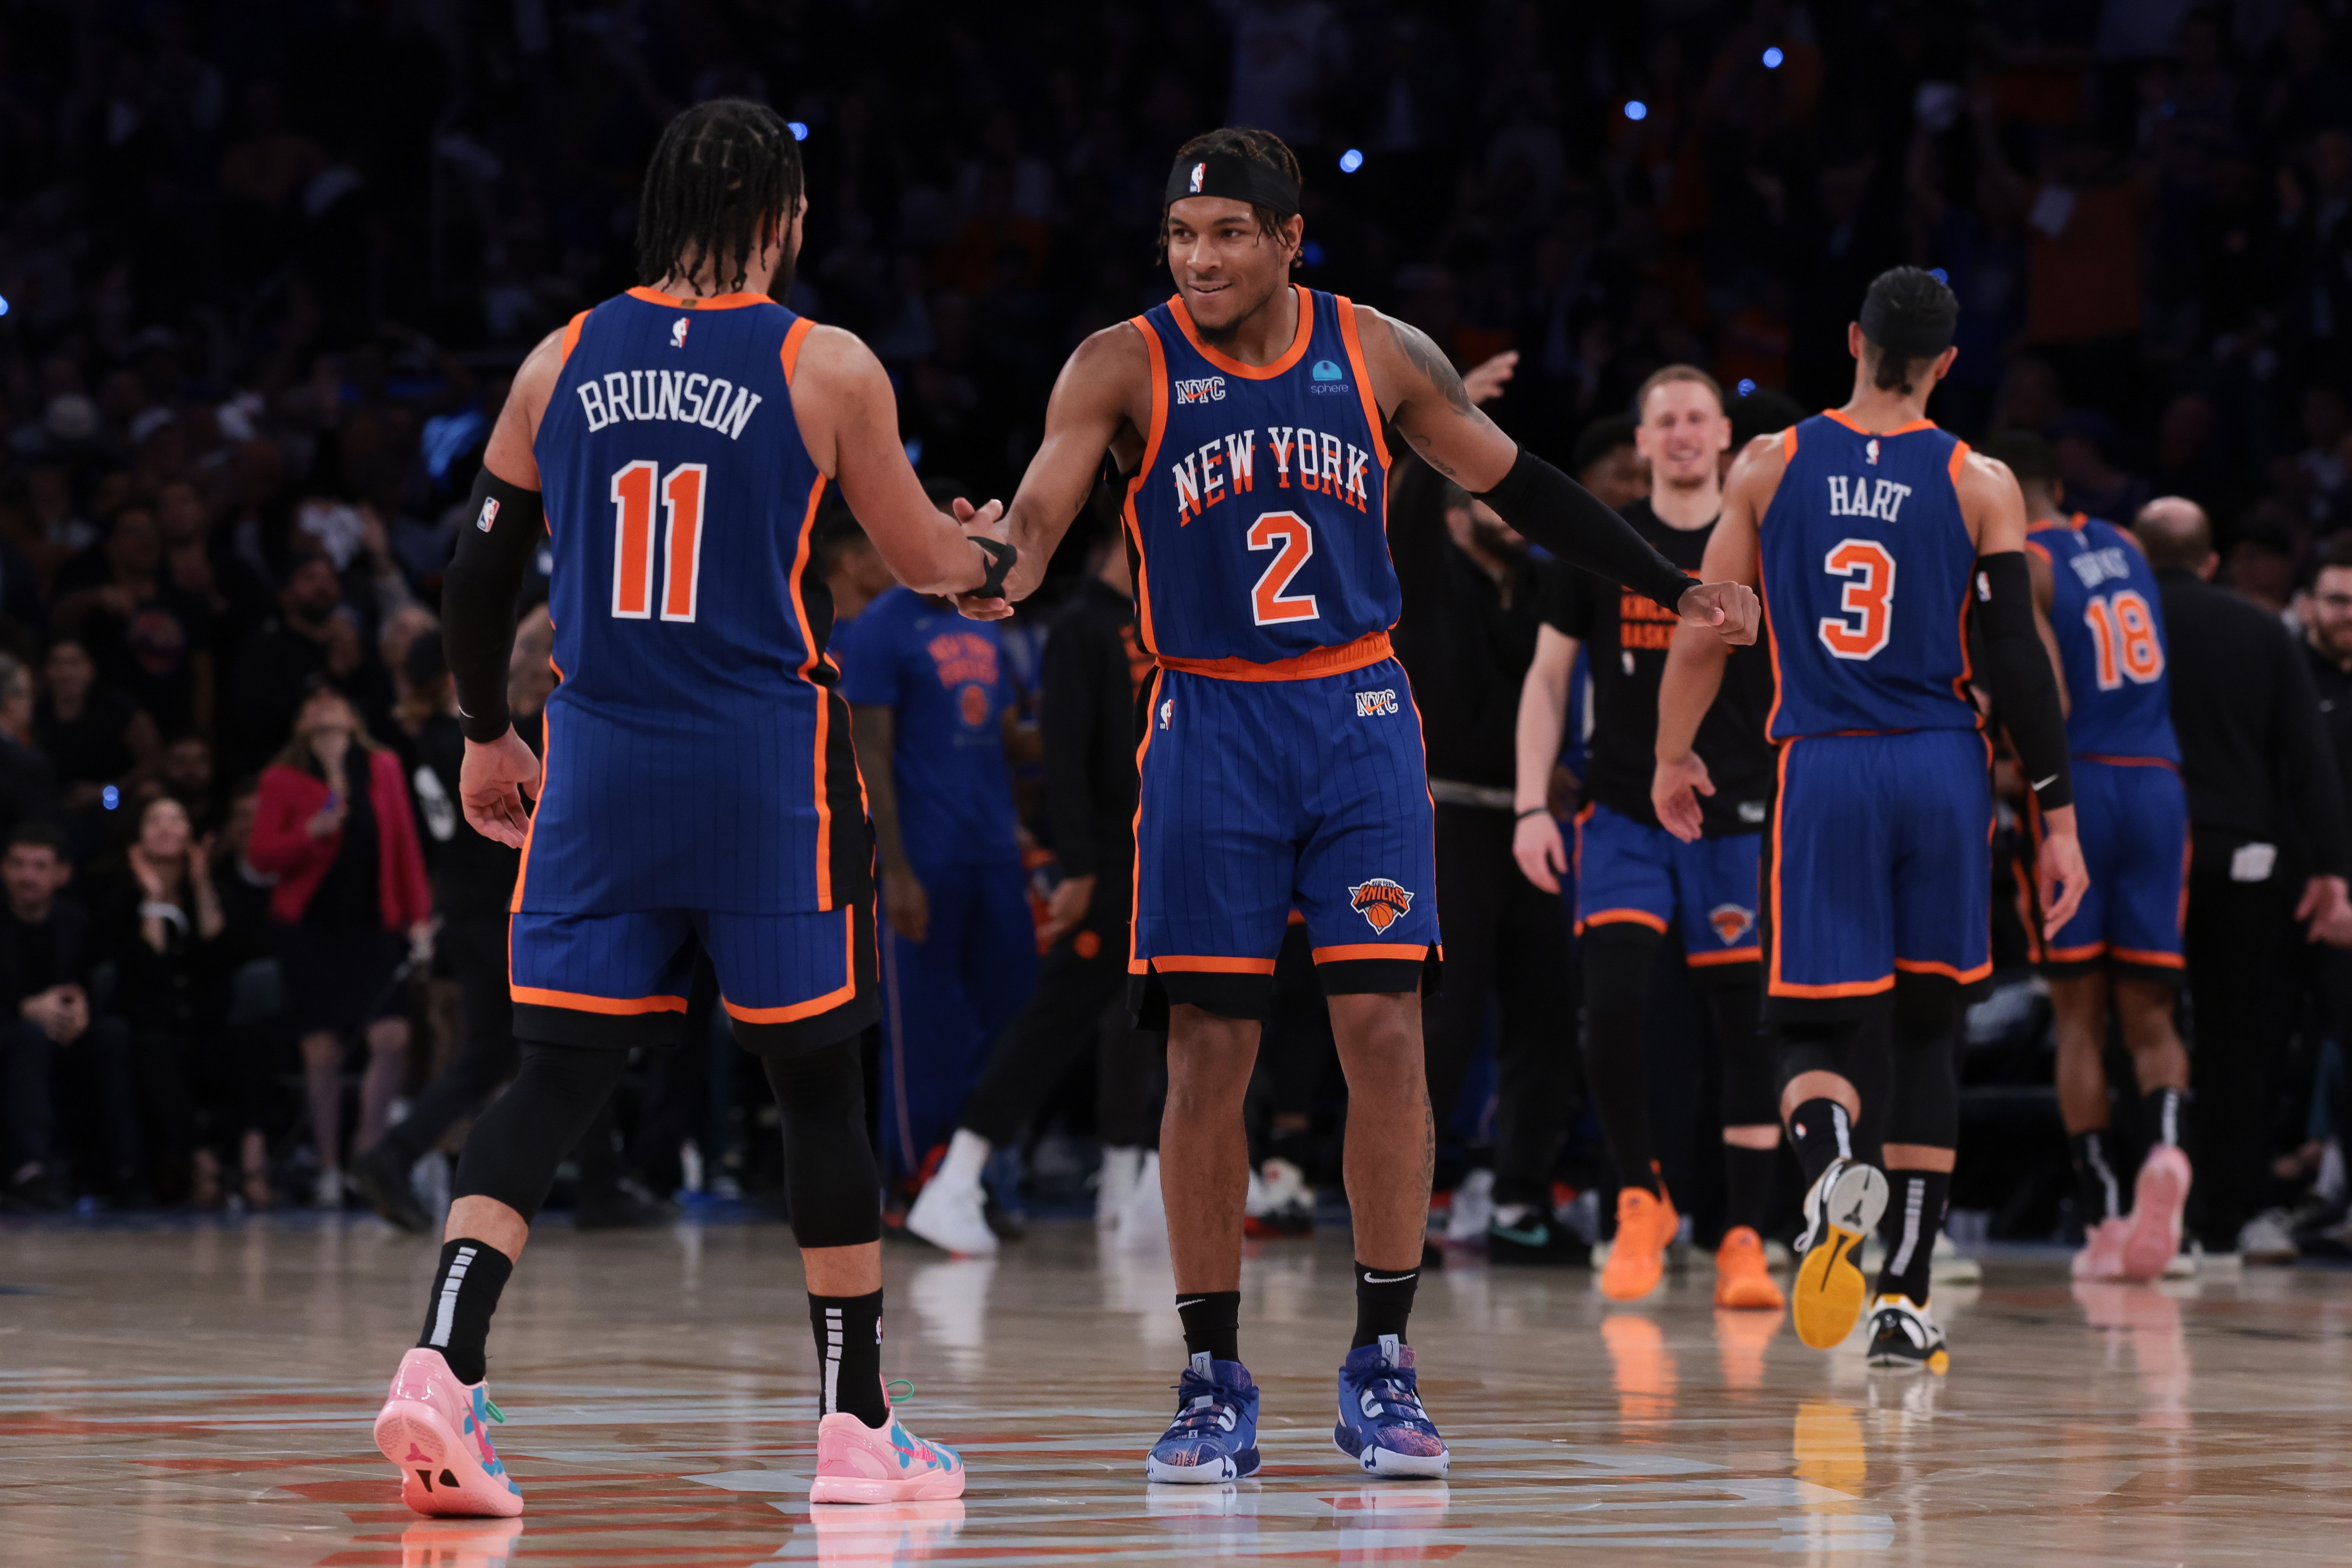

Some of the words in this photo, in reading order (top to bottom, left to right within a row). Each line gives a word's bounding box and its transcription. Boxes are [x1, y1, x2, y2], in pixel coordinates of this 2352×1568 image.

[577, 370, 762, 440] BRUNSON
[1175, 376, 1226, 404] NYC
[1311, 383, 1349, 395] sphere
[1172, 429, 1255, 514] NEW
[1268, 426, 1369, 501] YORK
[1827, 475, 1912, 523] HART
[611, 460, 707, 623] 11
[1247, 510, 1320, 626] 2
[1818, 537, 1897, 661] 3
[2083, 589, 2165, 692] 18
[1355, 689, 1398, 716] NYC
[1353, 884, 1408, 910] KNICKS
